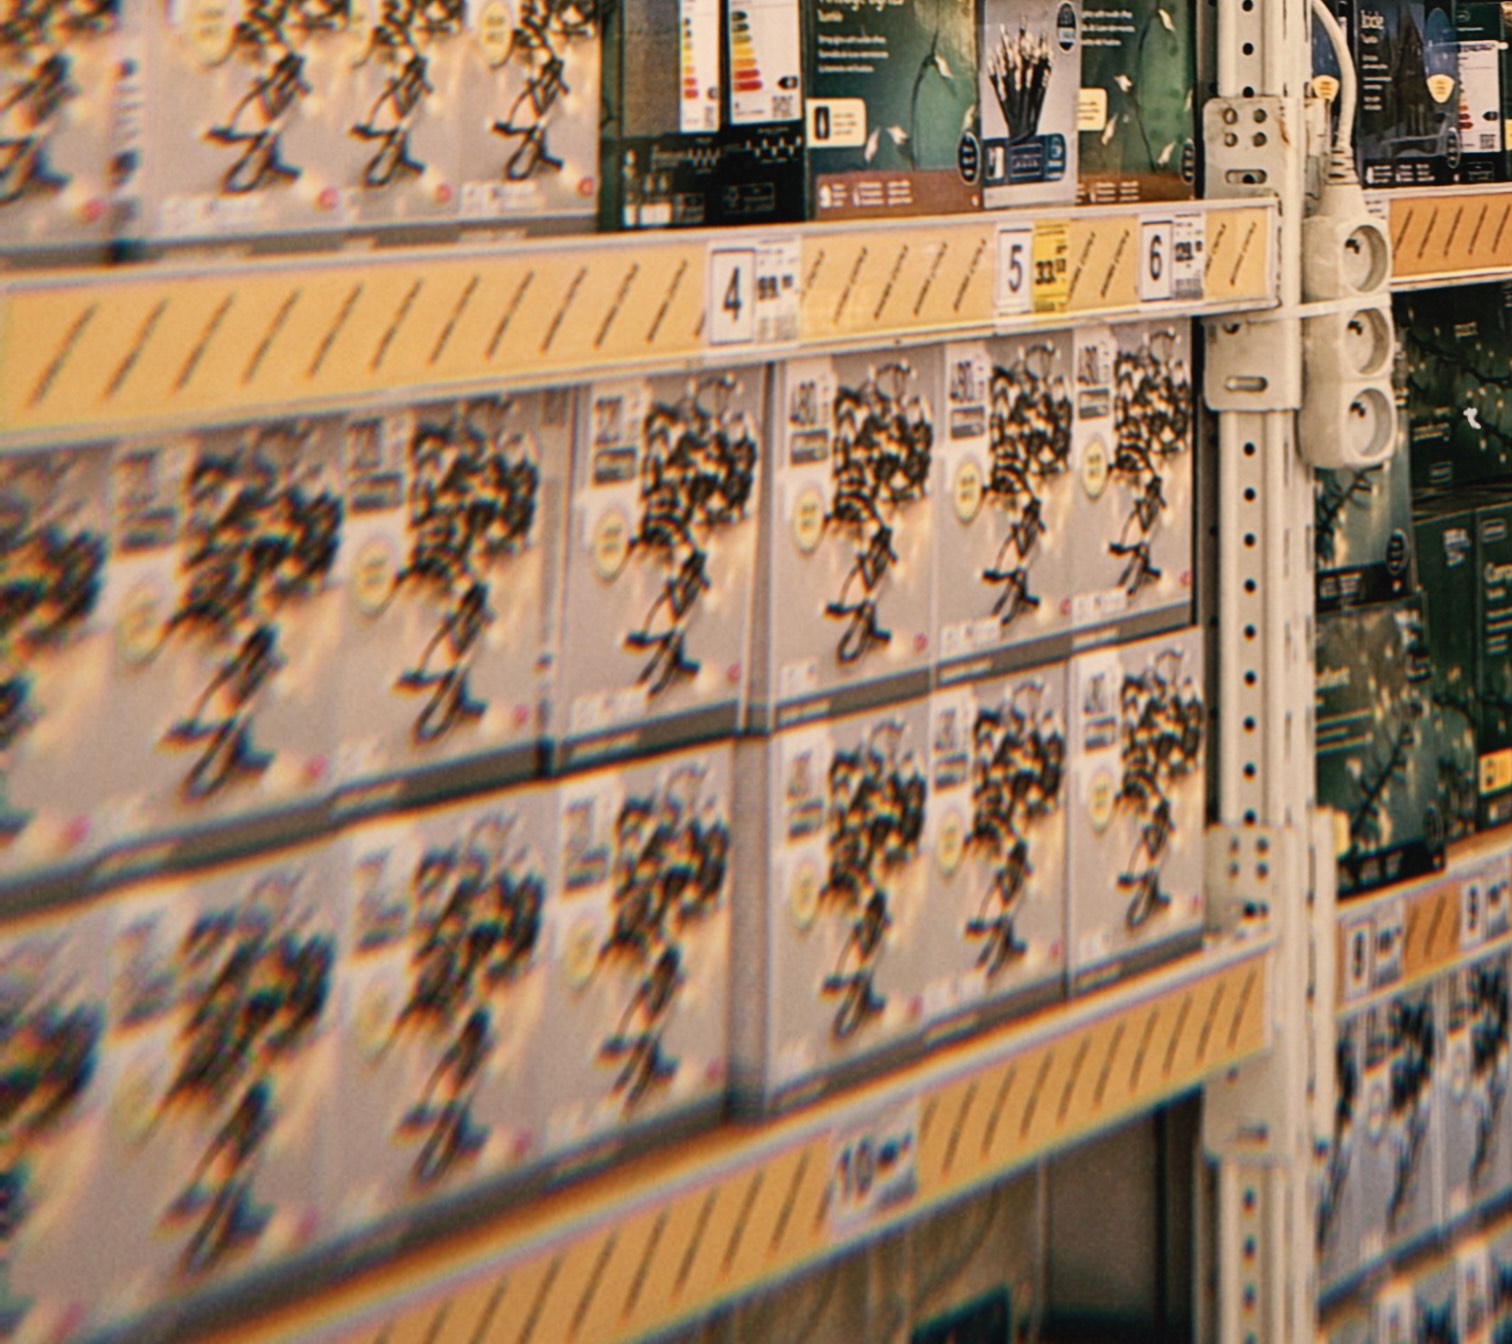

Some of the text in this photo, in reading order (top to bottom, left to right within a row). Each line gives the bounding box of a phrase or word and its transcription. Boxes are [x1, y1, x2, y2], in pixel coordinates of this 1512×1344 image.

[1008, 243, 1023, 293] 5
[1149, 234, 1163, 282] 6
[723, 265, 743, 323] 4
